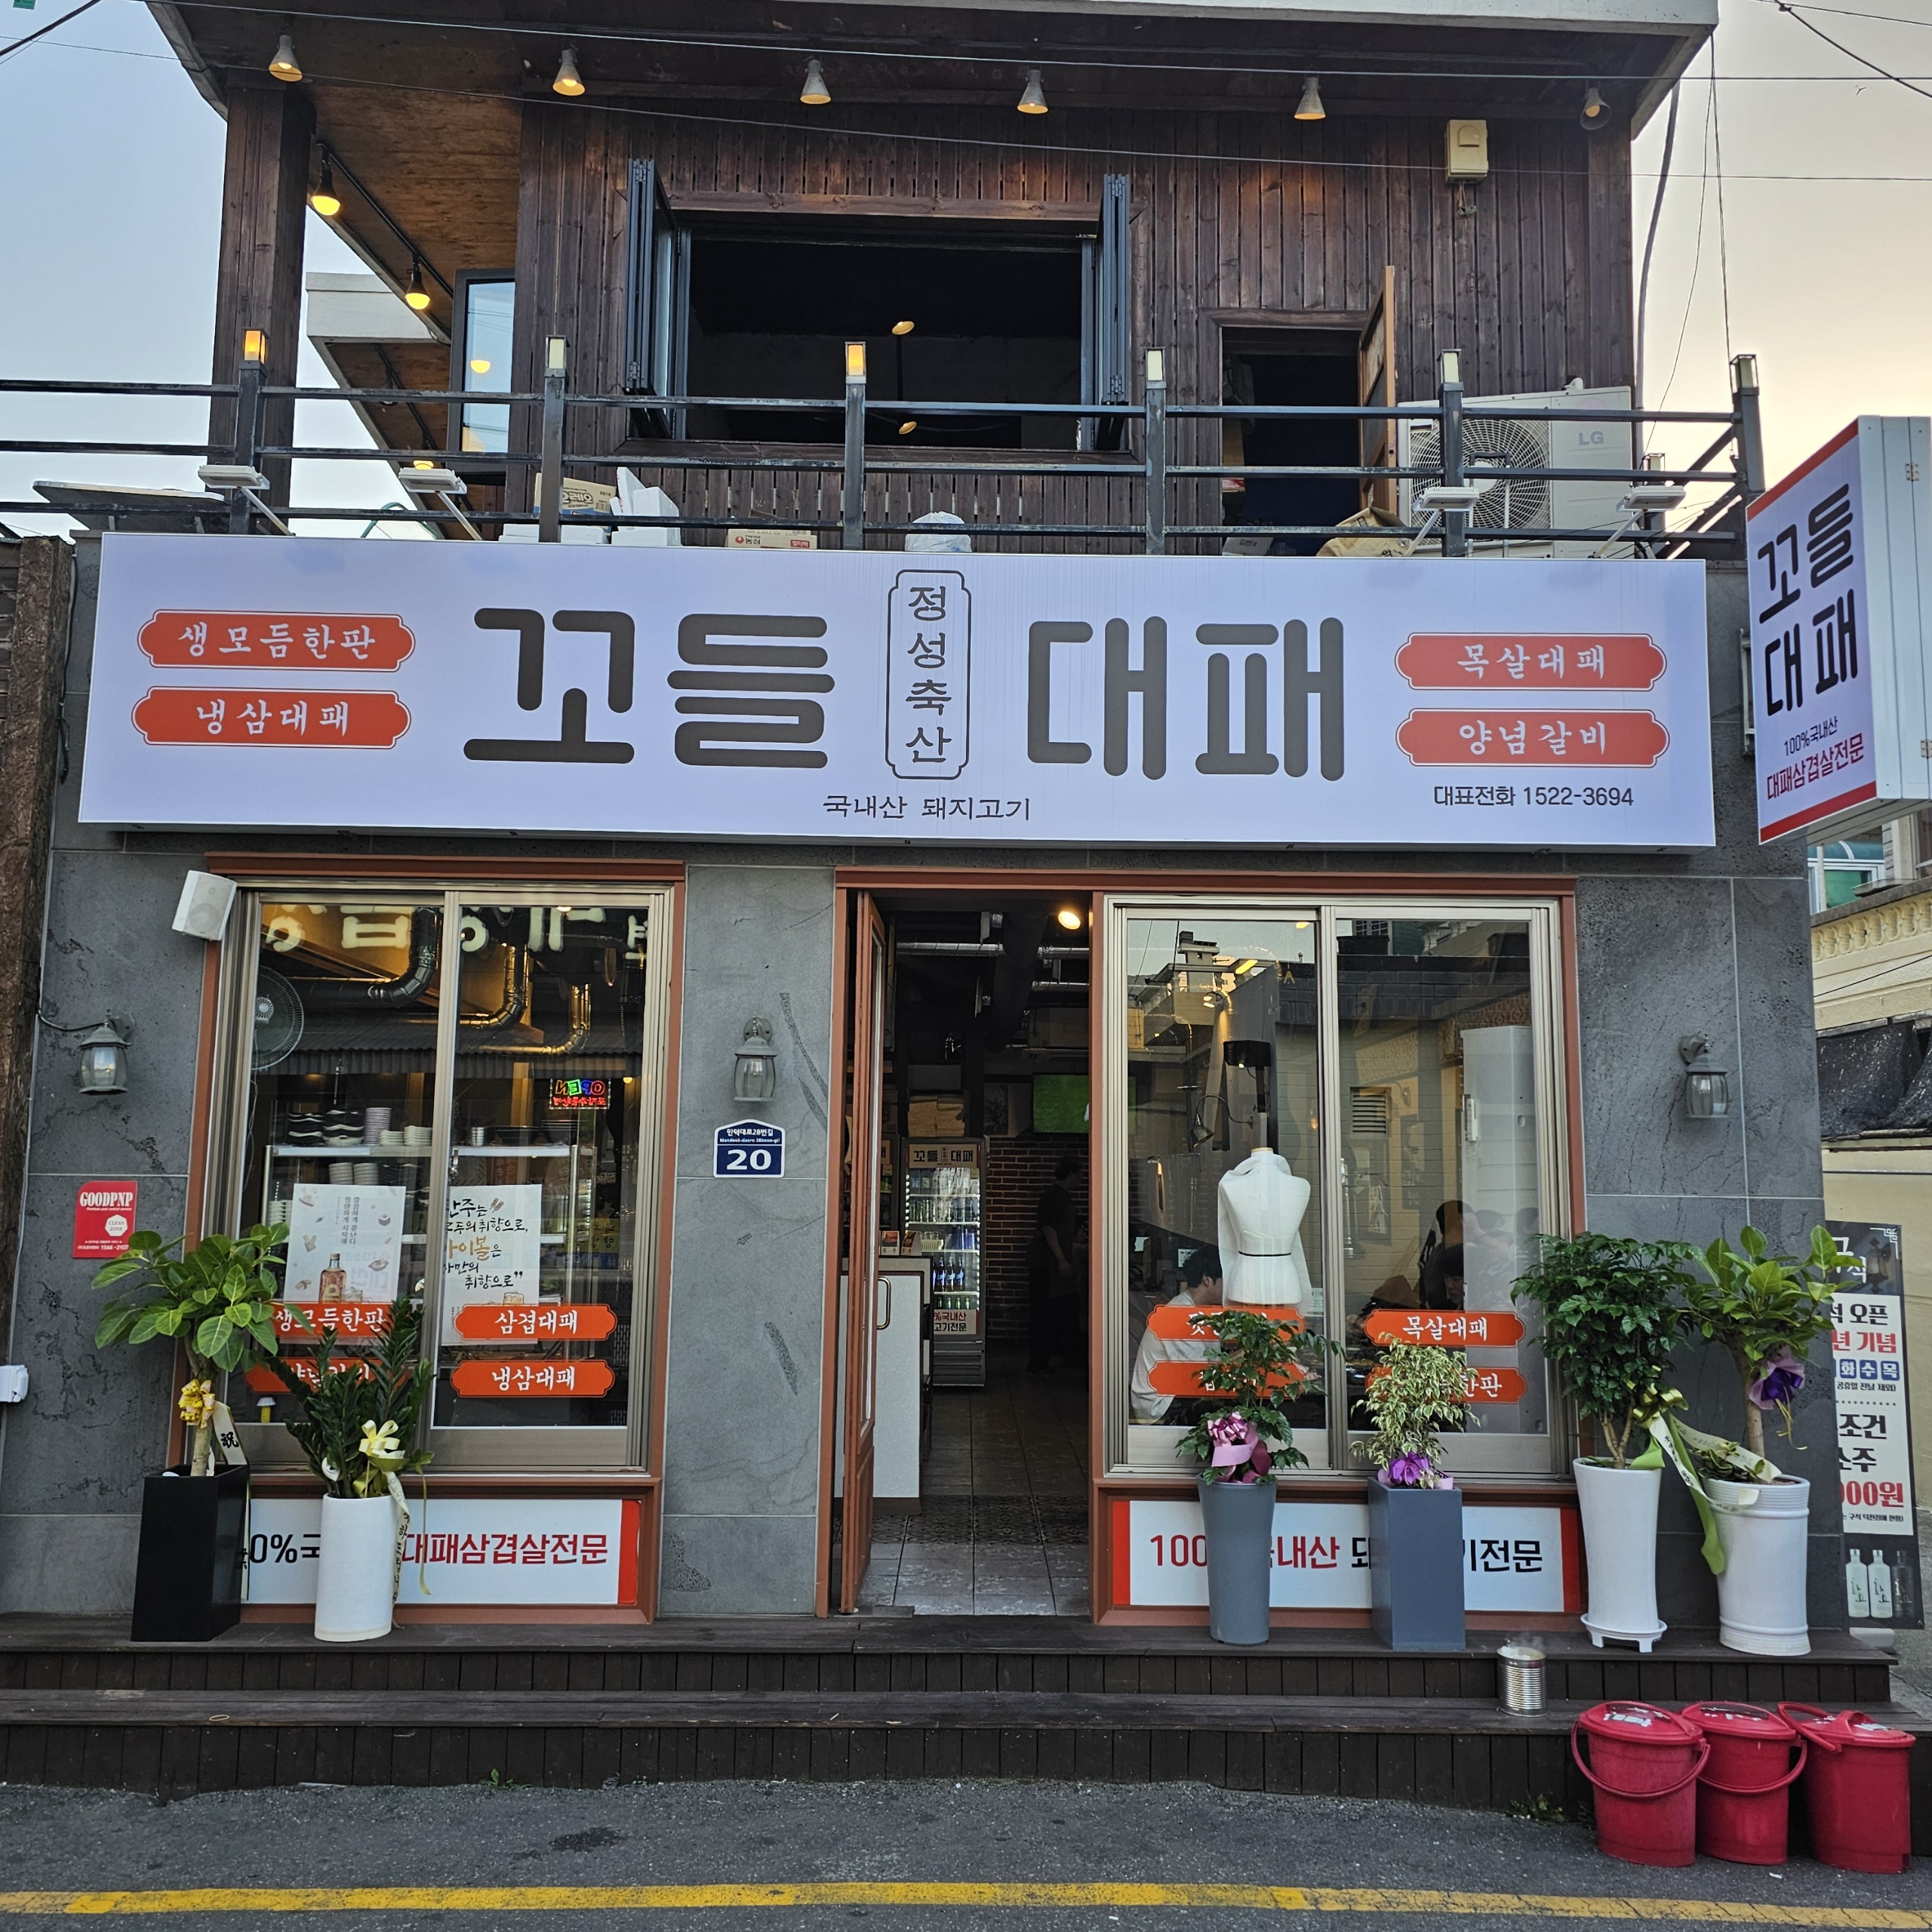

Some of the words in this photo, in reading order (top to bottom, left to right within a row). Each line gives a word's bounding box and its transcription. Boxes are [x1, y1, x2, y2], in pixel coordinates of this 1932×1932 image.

[1578, 430, 1604, 446] LG
[1758, 483, 1854, 623] 꼬들
[1457, 644, 1606, 680] 목살대패
[1764, 589, 1858, 716] 대패
[463, 607, 835, 769] 꼬들
[905, 585, 953, 764] 정성축산
[1026, 616, 1345, 782] 대패
[195, 698, 349, 737] 냉삼대패
[1459, 719, 1606, 757] 양념갈비
[1783, 715, 1838, 756] 100%국내산
[1767, 733, 1864, 800] 대패삼겹살전문
[823, 795, 908, 821] 국내산
[921, 795, 1031, 822] 돼지고기
[1433, 786, 1516, 807] 대표전화
[1522, 786, 1634, 808] 1522-3694
[726, 1149, 772, 1171] 20
[951, 1149, 974, 1162] 대패
[79, 1192, 134, 1208] GOODPNP
[494, 1308, 578, 1335] 삼겹대패
[1849, 1303, 1889, 1326] 오픈
[1402, 1315, 1487, 1342] 목살대패
[1857, 1331, 1897, 1354] 기념
[492, 1365, 575, 1393] 냉삼대패
[1860, 1361, 1877, 1377] 수
[1882, 1363, 1898, 1379] 목
[220, 1431, 240, 1449] 祝
[401, 1533, 608, 1565] 대패삼겹살전문
